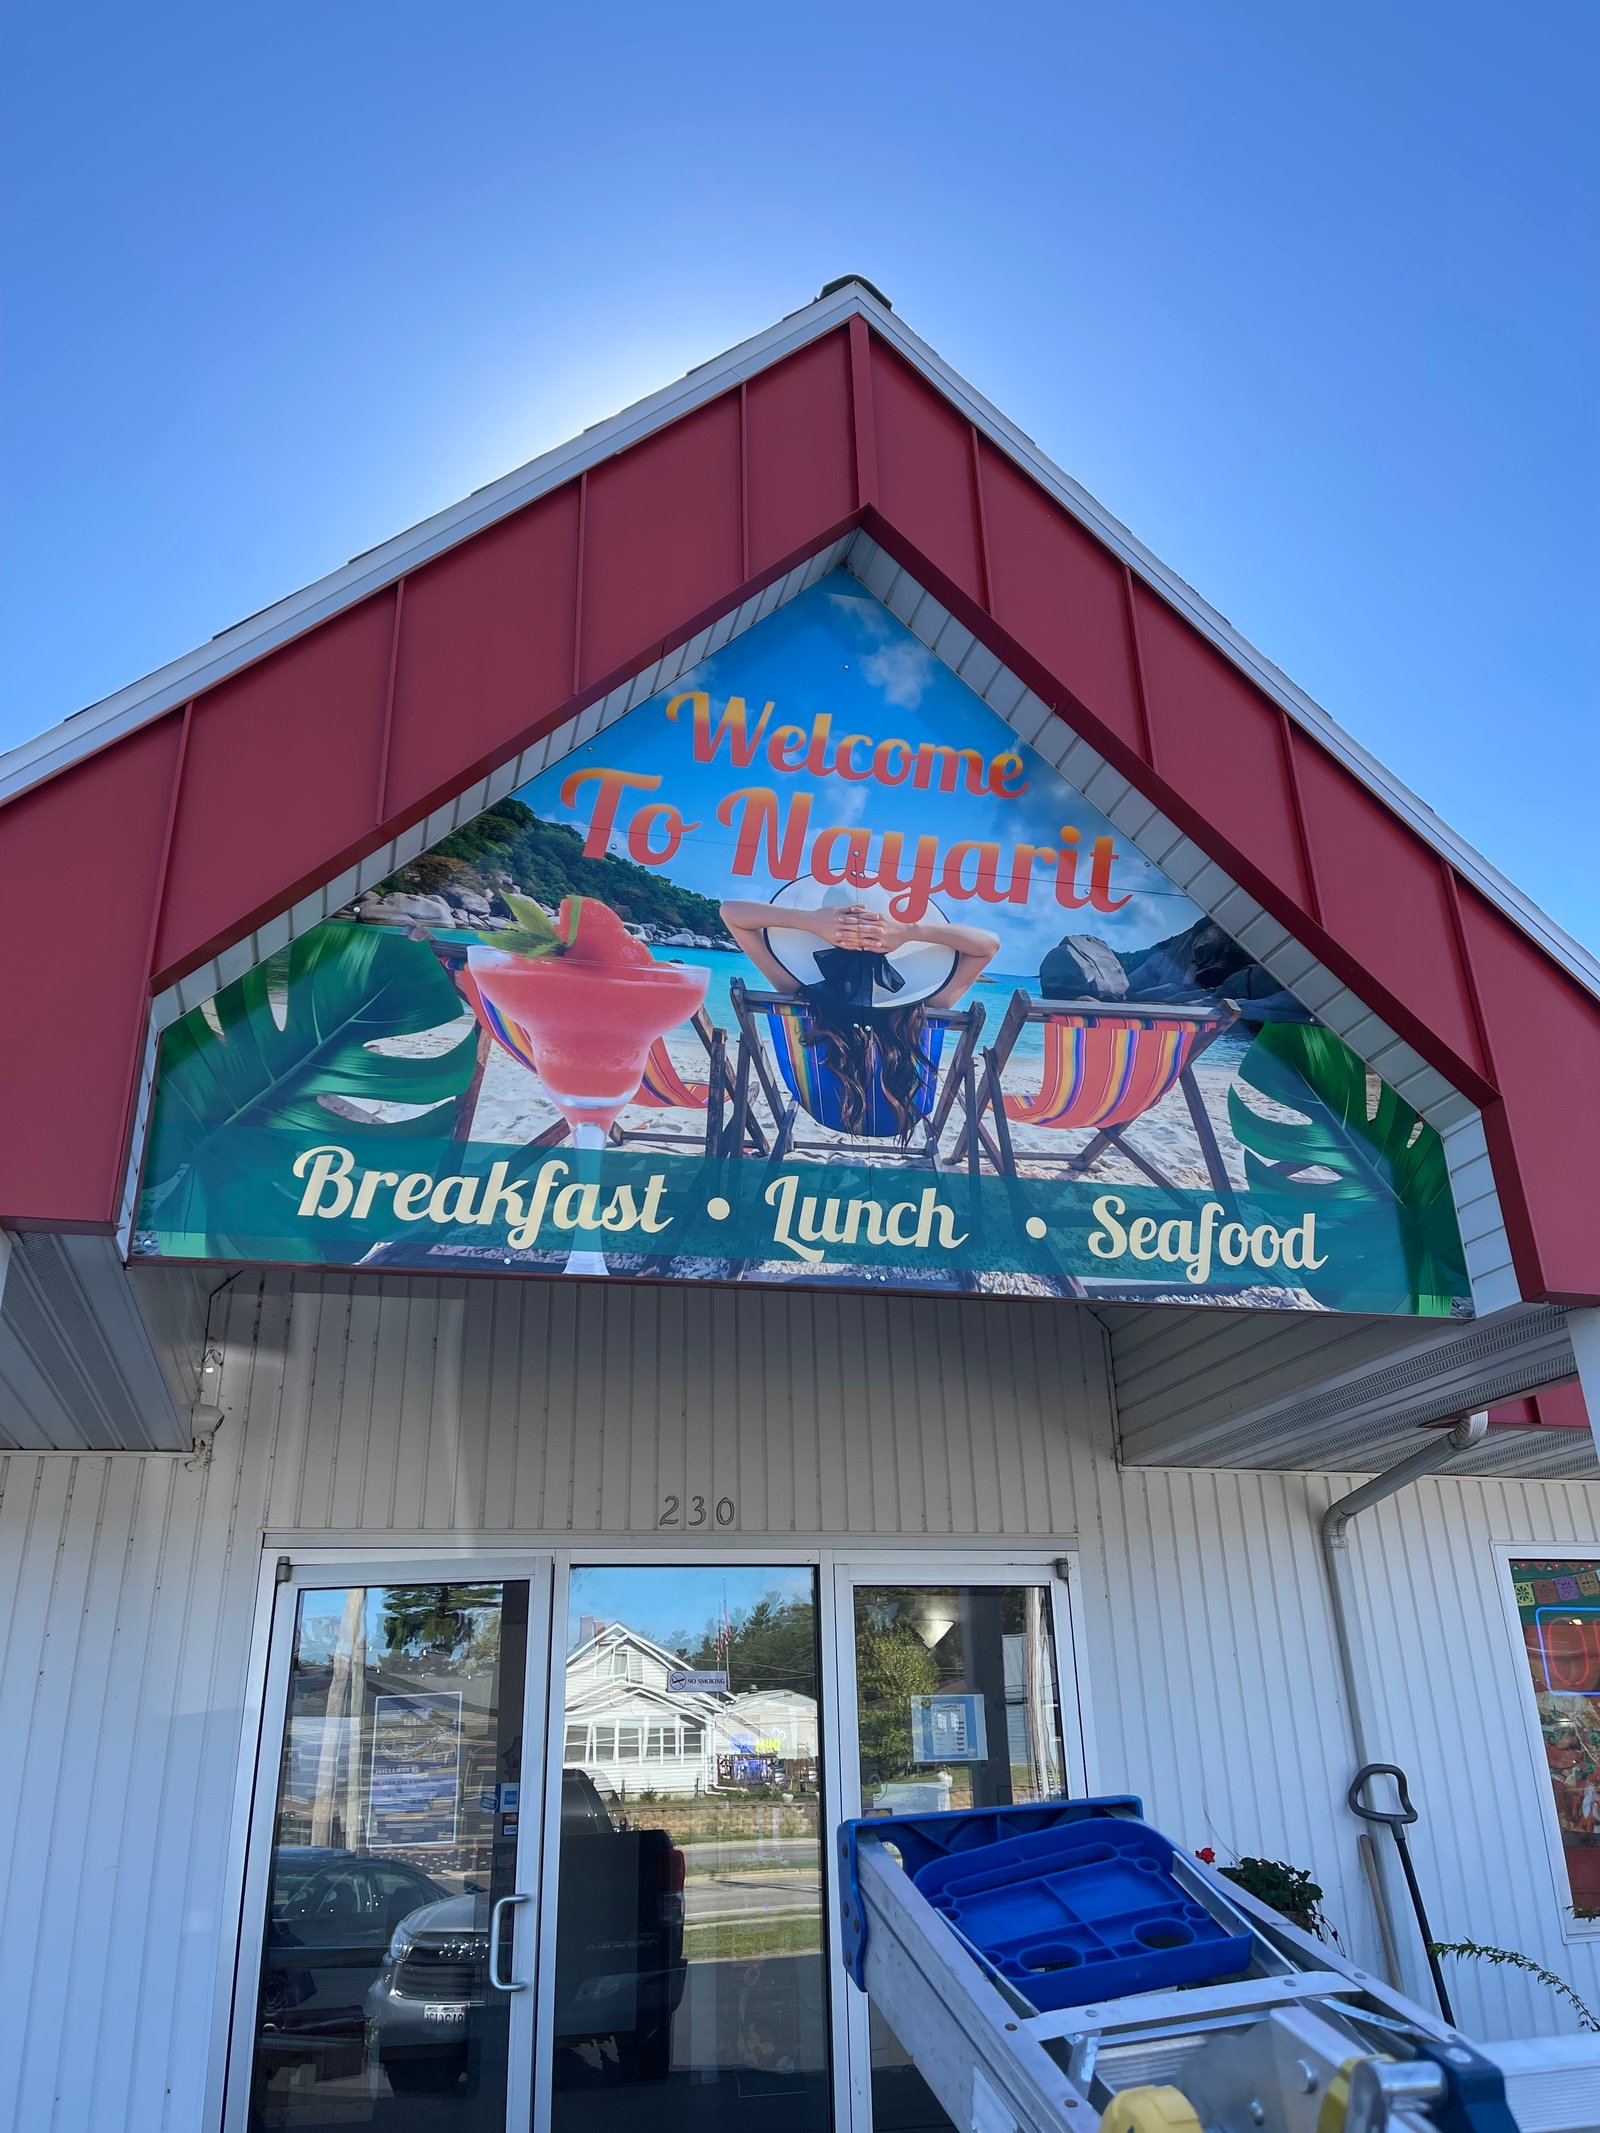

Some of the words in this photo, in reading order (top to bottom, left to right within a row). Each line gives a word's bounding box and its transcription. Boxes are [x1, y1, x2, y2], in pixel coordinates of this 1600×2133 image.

[666, 691, 1031, 799] Welcome
[559, 767, 701, 866] To
[717, 787, 1133, 924] Nayarit
[292, 1145, 674, 1250] Breakfast
[764, 1175, 970, 1263] Lunch
[1087, 1195, 1330, 1284] Seafood
[660, 1495, 735, 1526] 230
